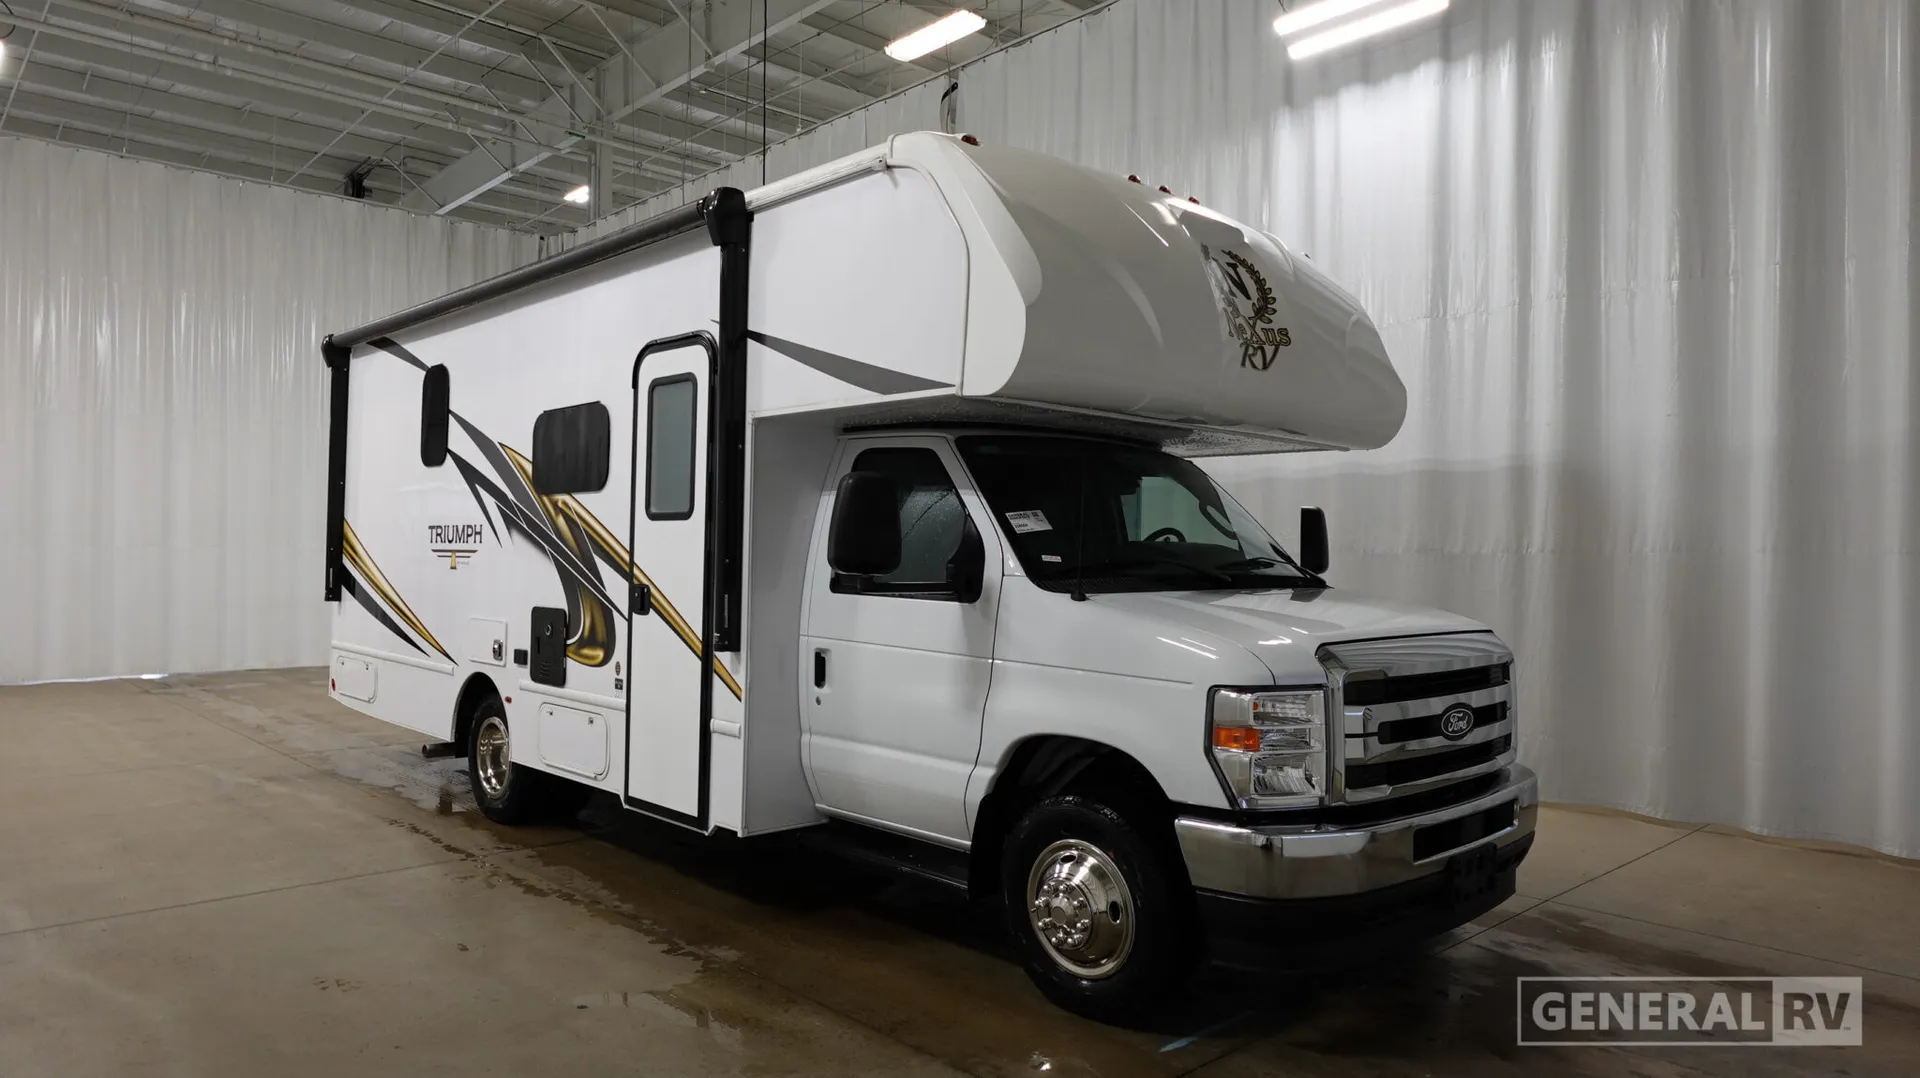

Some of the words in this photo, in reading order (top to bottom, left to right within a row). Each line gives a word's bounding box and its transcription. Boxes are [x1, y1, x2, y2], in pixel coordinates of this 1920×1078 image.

[1239, 342, 1281, 371] RV
[428, 524, 483, 544] TRIUMPH
[1448, 712, 1468, 732] Ford
